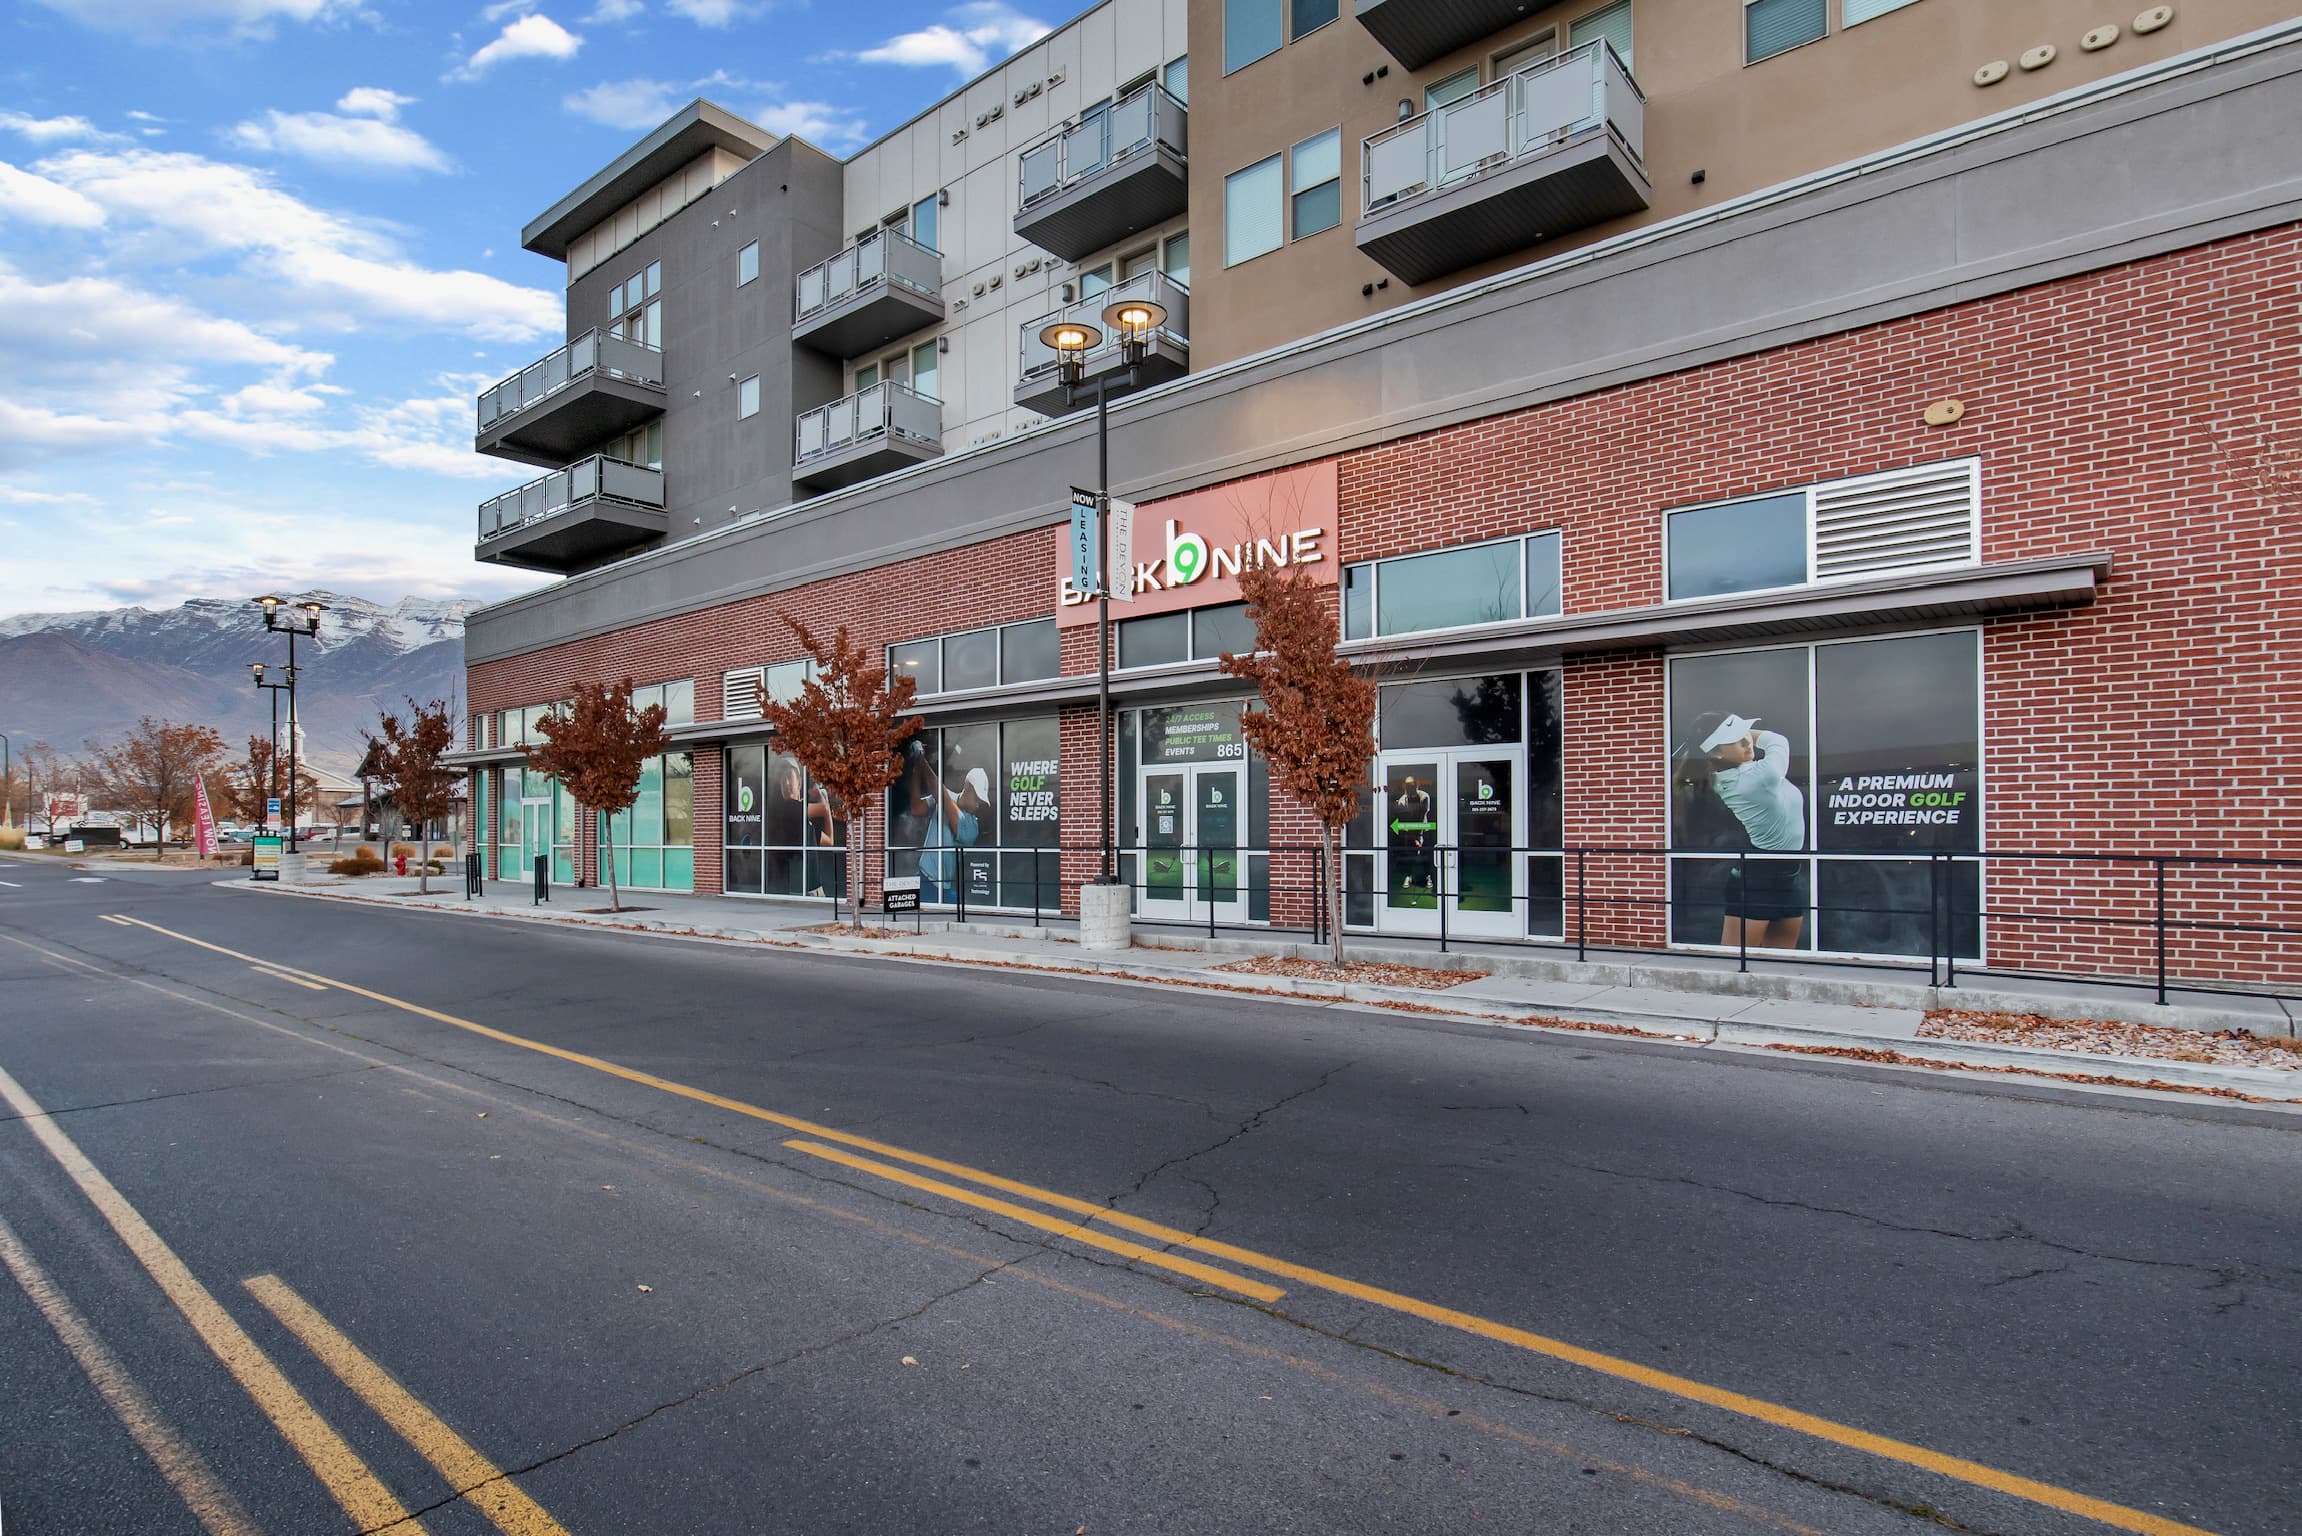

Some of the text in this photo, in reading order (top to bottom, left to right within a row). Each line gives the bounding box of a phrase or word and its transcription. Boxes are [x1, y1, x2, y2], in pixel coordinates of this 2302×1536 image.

[1073, 492, 1094, 506] NOW
[1080, 508, 1088, 588] LEASING
[1212, 527, 1324, 579] NINE
[1183, 712, 1214, 721] ACCESS
[1165, 723, 1219, 734] MEMBERSHIPS
[1165, 733, 1232, 745] PUBLIC TEE TIMES
[1165, 747, 1195, 756] EVENTS
[1217, 743, 1242, 757] 865
[1011, 760, 1058, 776] WHERE
[1010, 776, 1045, 791] GOLF
[1839, 774, 1954, 790] A PREMIUM
[1010, 791, 1053, 806] NEVER
[1829, 792, 1966, 808] INDOOR GOLF
[1010, 806, 1058, 820] SLEEPS
[1834, 810, 1960, 825] EXPERIENCE
[888, 893, 916, 901] ATTACHED
